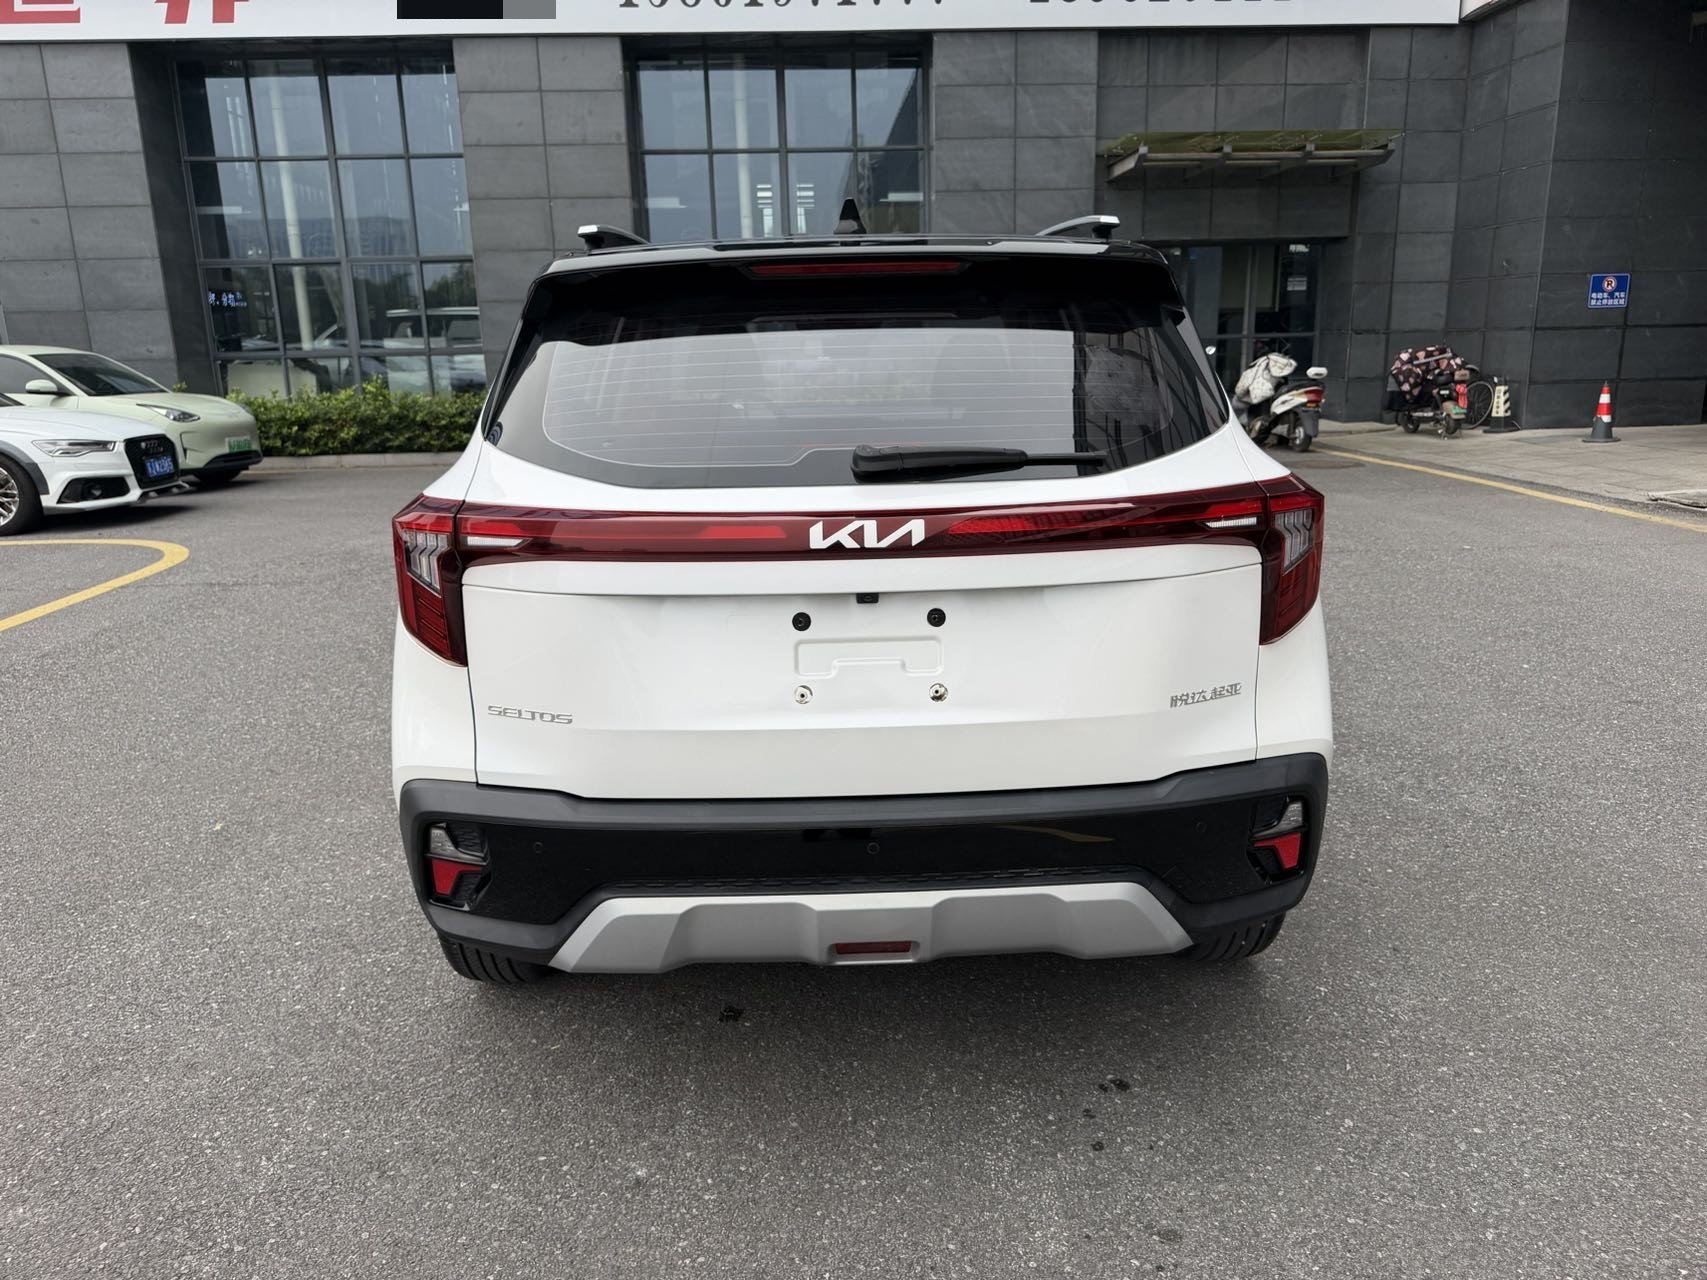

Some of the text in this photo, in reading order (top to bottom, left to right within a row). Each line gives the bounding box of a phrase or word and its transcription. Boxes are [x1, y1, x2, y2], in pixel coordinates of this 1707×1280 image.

[809, 518, 926, 549] KIA
[1169, 681, 1243, 709] 悦达起亚
[487, 705, 573, 725] SELTOS
